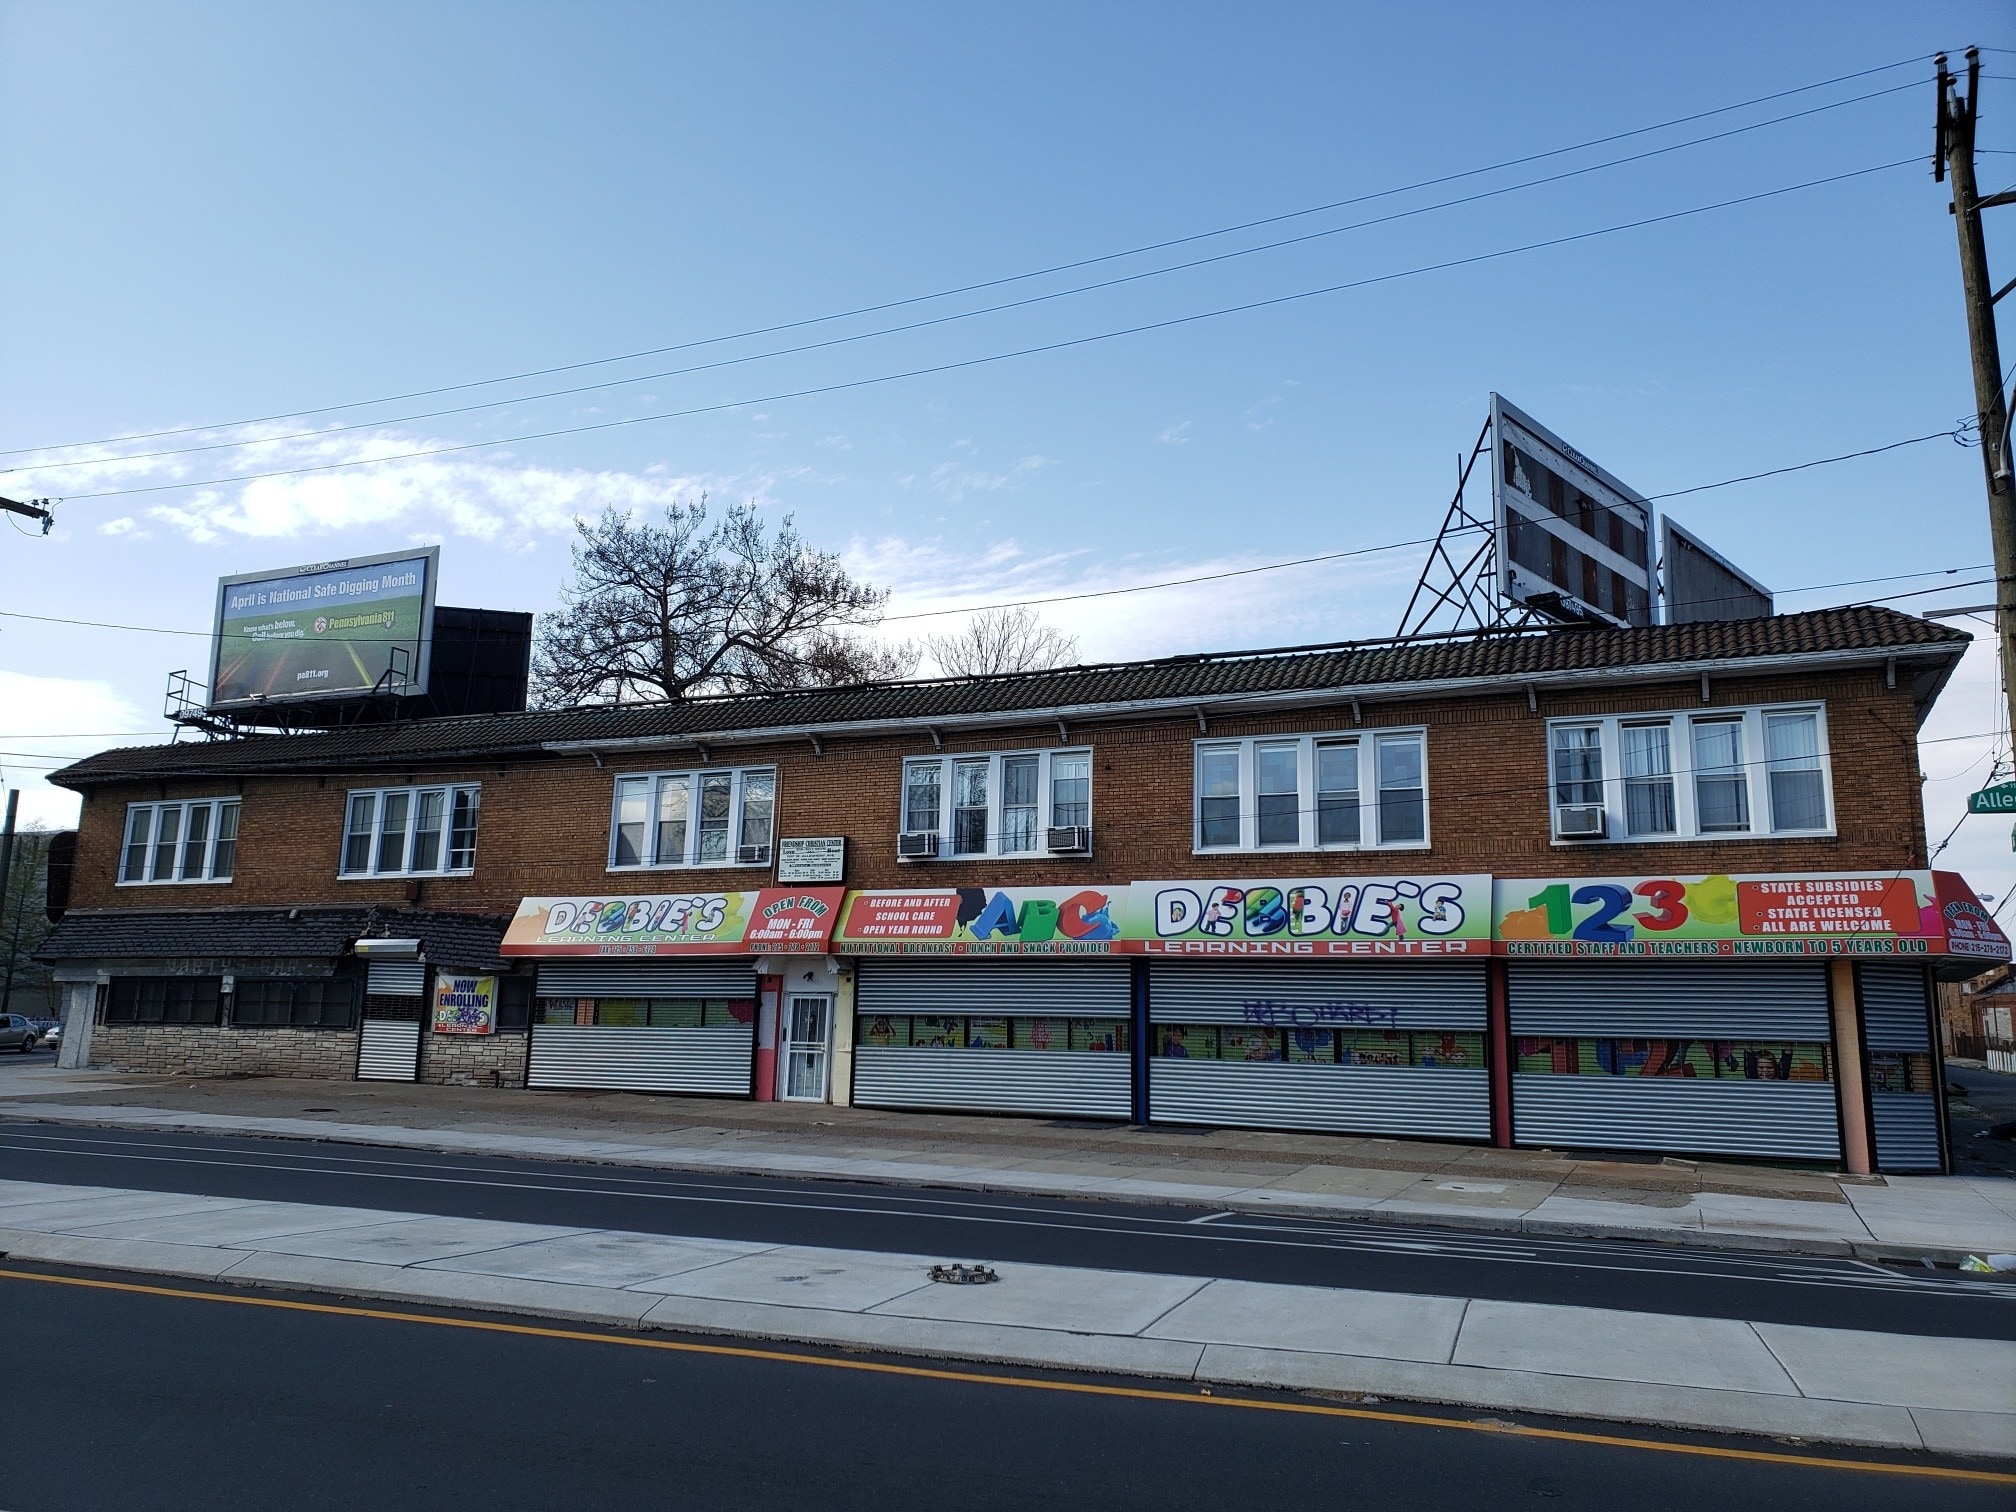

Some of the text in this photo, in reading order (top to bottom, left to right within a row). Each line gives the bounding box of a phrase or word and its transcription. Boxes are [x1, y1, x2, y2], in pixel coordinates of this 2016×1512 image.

[231, 572, 416, 610] April is National Safe Digging Month
[296, 668, 329, 681] pa811.org
[1976, 792, 2016, 809] Alle
[826, 839, 842, 847] CENTER
[1761, 880, 1884, 894] STATE SUBSIDIES
[869, 897, 951, 908] BEFORE AND AFTER
[1786, 894, 1860, 906] ACCEPTED
[762, 895, 829, 919] OPEN FROM
[1155, 880, 1466, 938] DEBBIE'S
[1767, 906, 1883, 919] STATE LICENSED
[1943, 901, 1990, 923] OPEN FROM
[543, 896, 729, 935] DEBBIE'S
[875, 911, 935, 921] SCHOOL CARE
[767, 918, 791, 930] MON
[796, 918, 815, 929] FRI
[862, 924, 943, 935] OPEN YEAR ROUND
[1762, 919, 1892, 932] ALL ARE WELCOME
[536, 934, 716, 943] LEARNING CENTER
[749, 929, 783, 939] 6:00am
[788, 929, 824, 940] 6:00pm
[839, 941, 1111, 954] NUTRITIONAL BREAKFAST LUNCH AND SNACK PROVIDED
[1144, 940, 1467, 954] LEARNING CENTER
[1507, 938, 1928, 955] CERTIFIED STAFF AND TEACHERS NEWBORN TO 5 YEARS OLD
[453, 979, 478, 993] NOW
[440, 994, 489, 1008] ENROLLING
